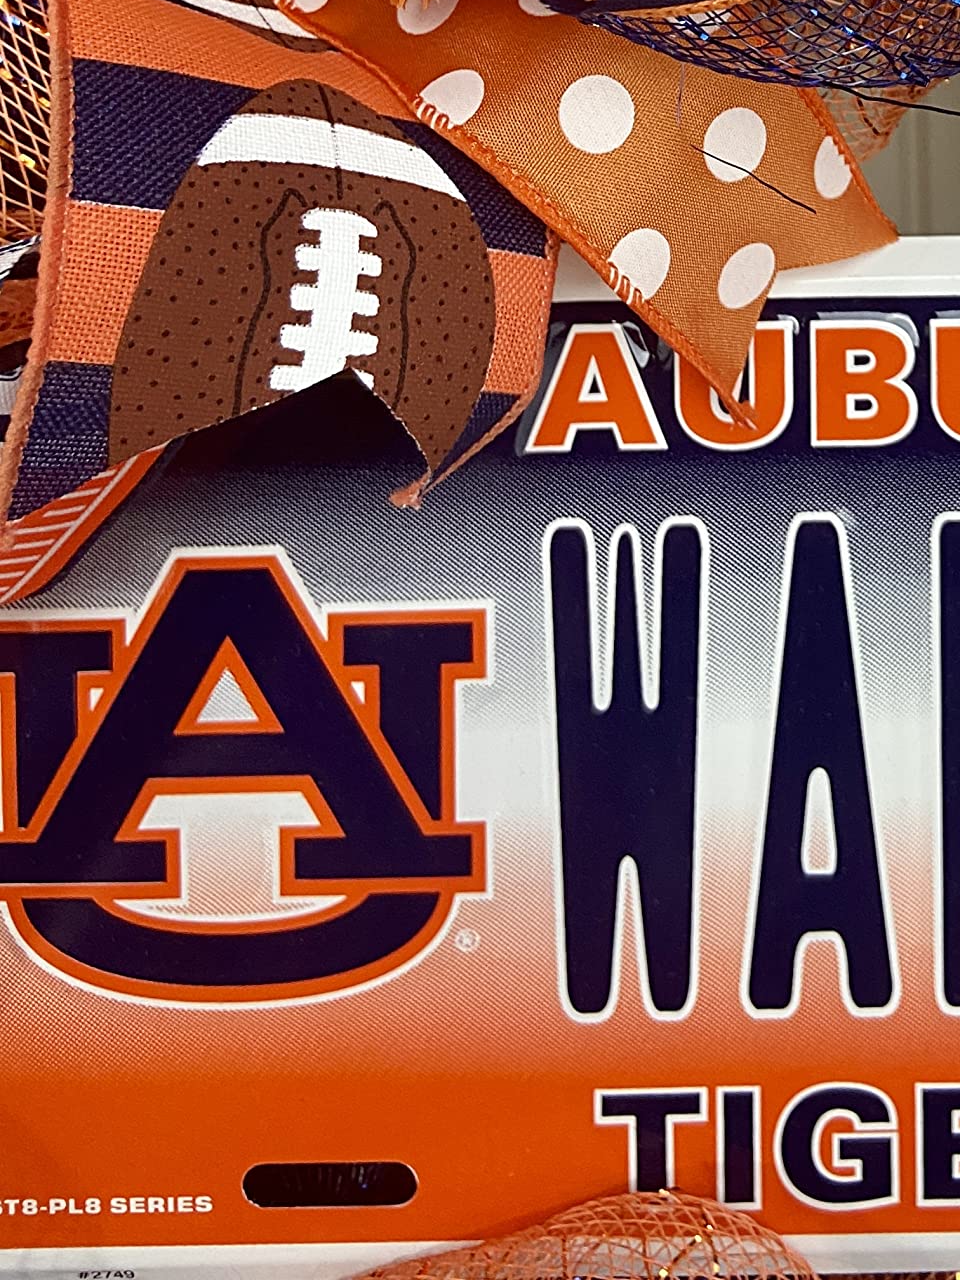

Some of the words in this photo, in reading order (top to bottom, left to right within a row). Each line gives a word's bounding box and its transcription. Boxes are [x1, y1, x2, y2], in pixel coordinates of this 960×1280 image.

[0, 1197, 102, 1216] T8-PL8
[110, 1195, 214, 1215] SERIES
[78, 1269, 136, 1280] #2749
